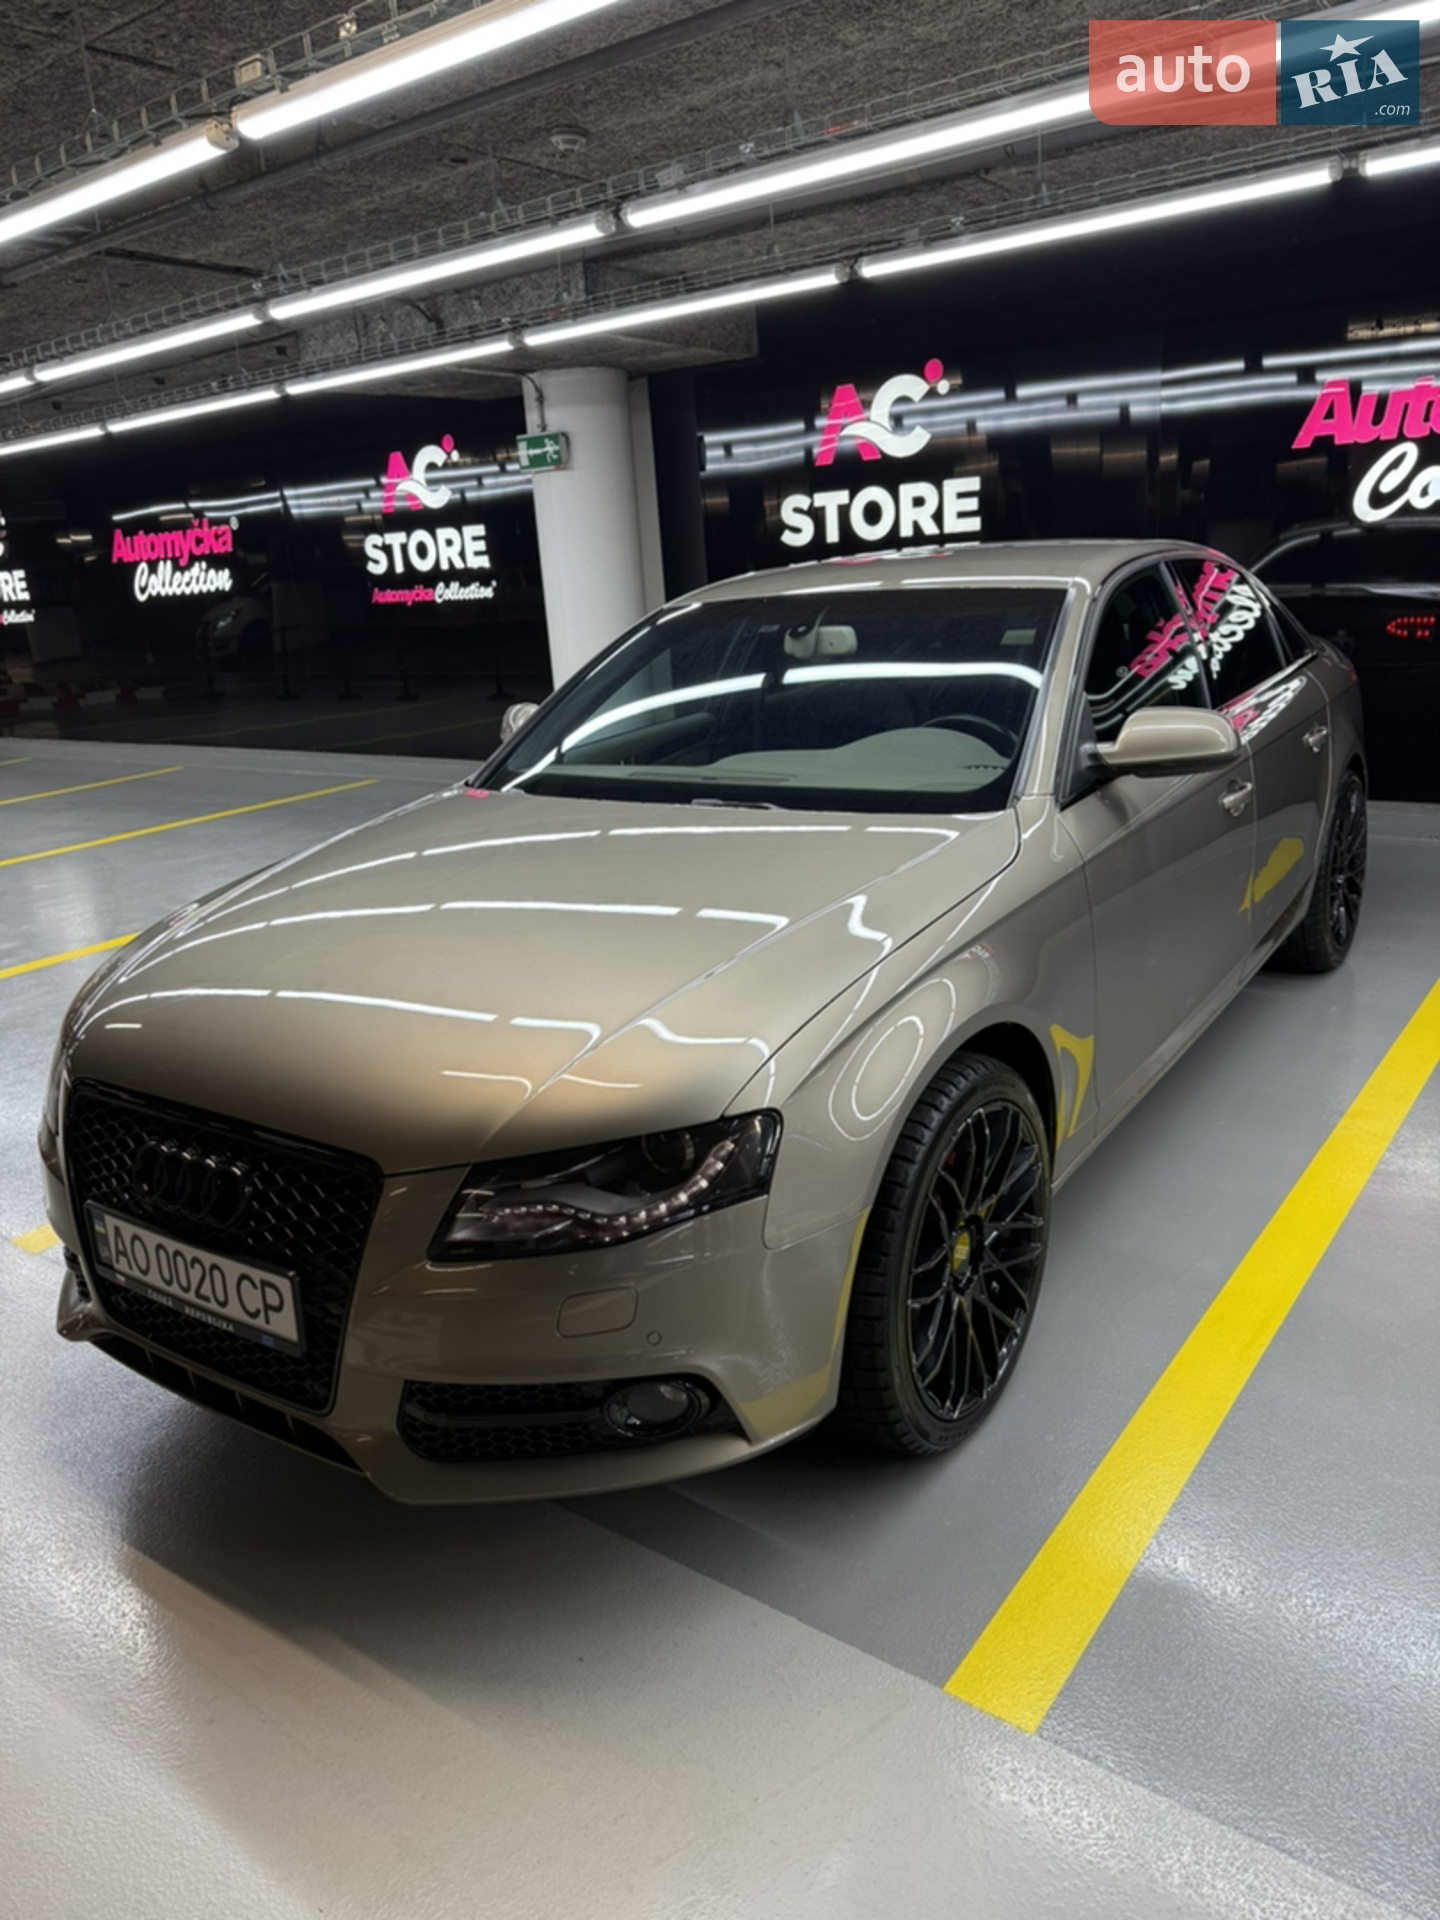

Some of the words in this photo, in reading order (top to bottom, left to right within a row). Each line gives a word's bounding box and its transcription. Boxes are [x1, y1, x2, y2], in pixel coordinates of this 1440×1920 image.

[779, 476, 982, 548] STORE
[363, 523, 492, 576] STORE
[133, 559, 233, 603] Collection
[113, 1224, 151, 1277] AO
[155, 1242, 230, 1310] 0020
[236, 1273, 285, 1326] CP
